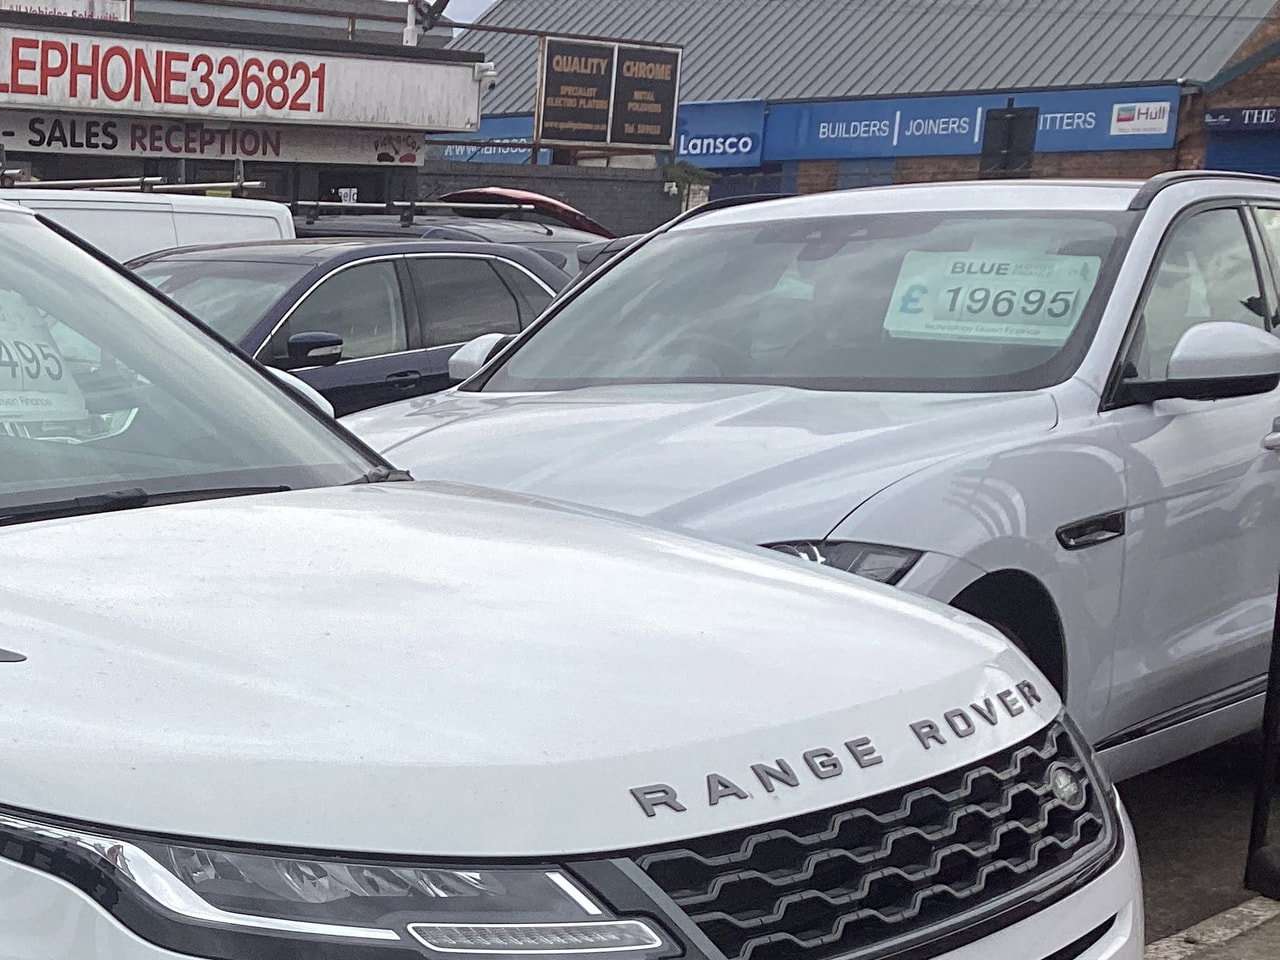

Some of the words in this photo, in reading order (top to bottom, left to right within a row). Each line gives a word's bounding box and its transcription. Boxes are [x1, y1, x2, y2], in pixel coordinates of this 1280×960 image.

[552, 54, 609, 76] QUALITY
[623, 60, 672, 80] CHROME
[1137, 105, 1167, 120] Hull
[1242, 109, 1277, 124] THE
[819, 120, 889, 138] BUILDERS
[905, 117, 969, 136] JOINERS
[1039, 112, 1096, 131] ITTERS
[28, 117, 118, 150] SALES
[129, 122, 282, 157] RECEPTION
[679, 134, 753, 155] Lansco
[950, 261, 1010, 276] BLUE
[946, 287, 1074, 318] 19695
[629, 737, 883, 818] RANGE
[910, 679, 1043, 750] ROVER
